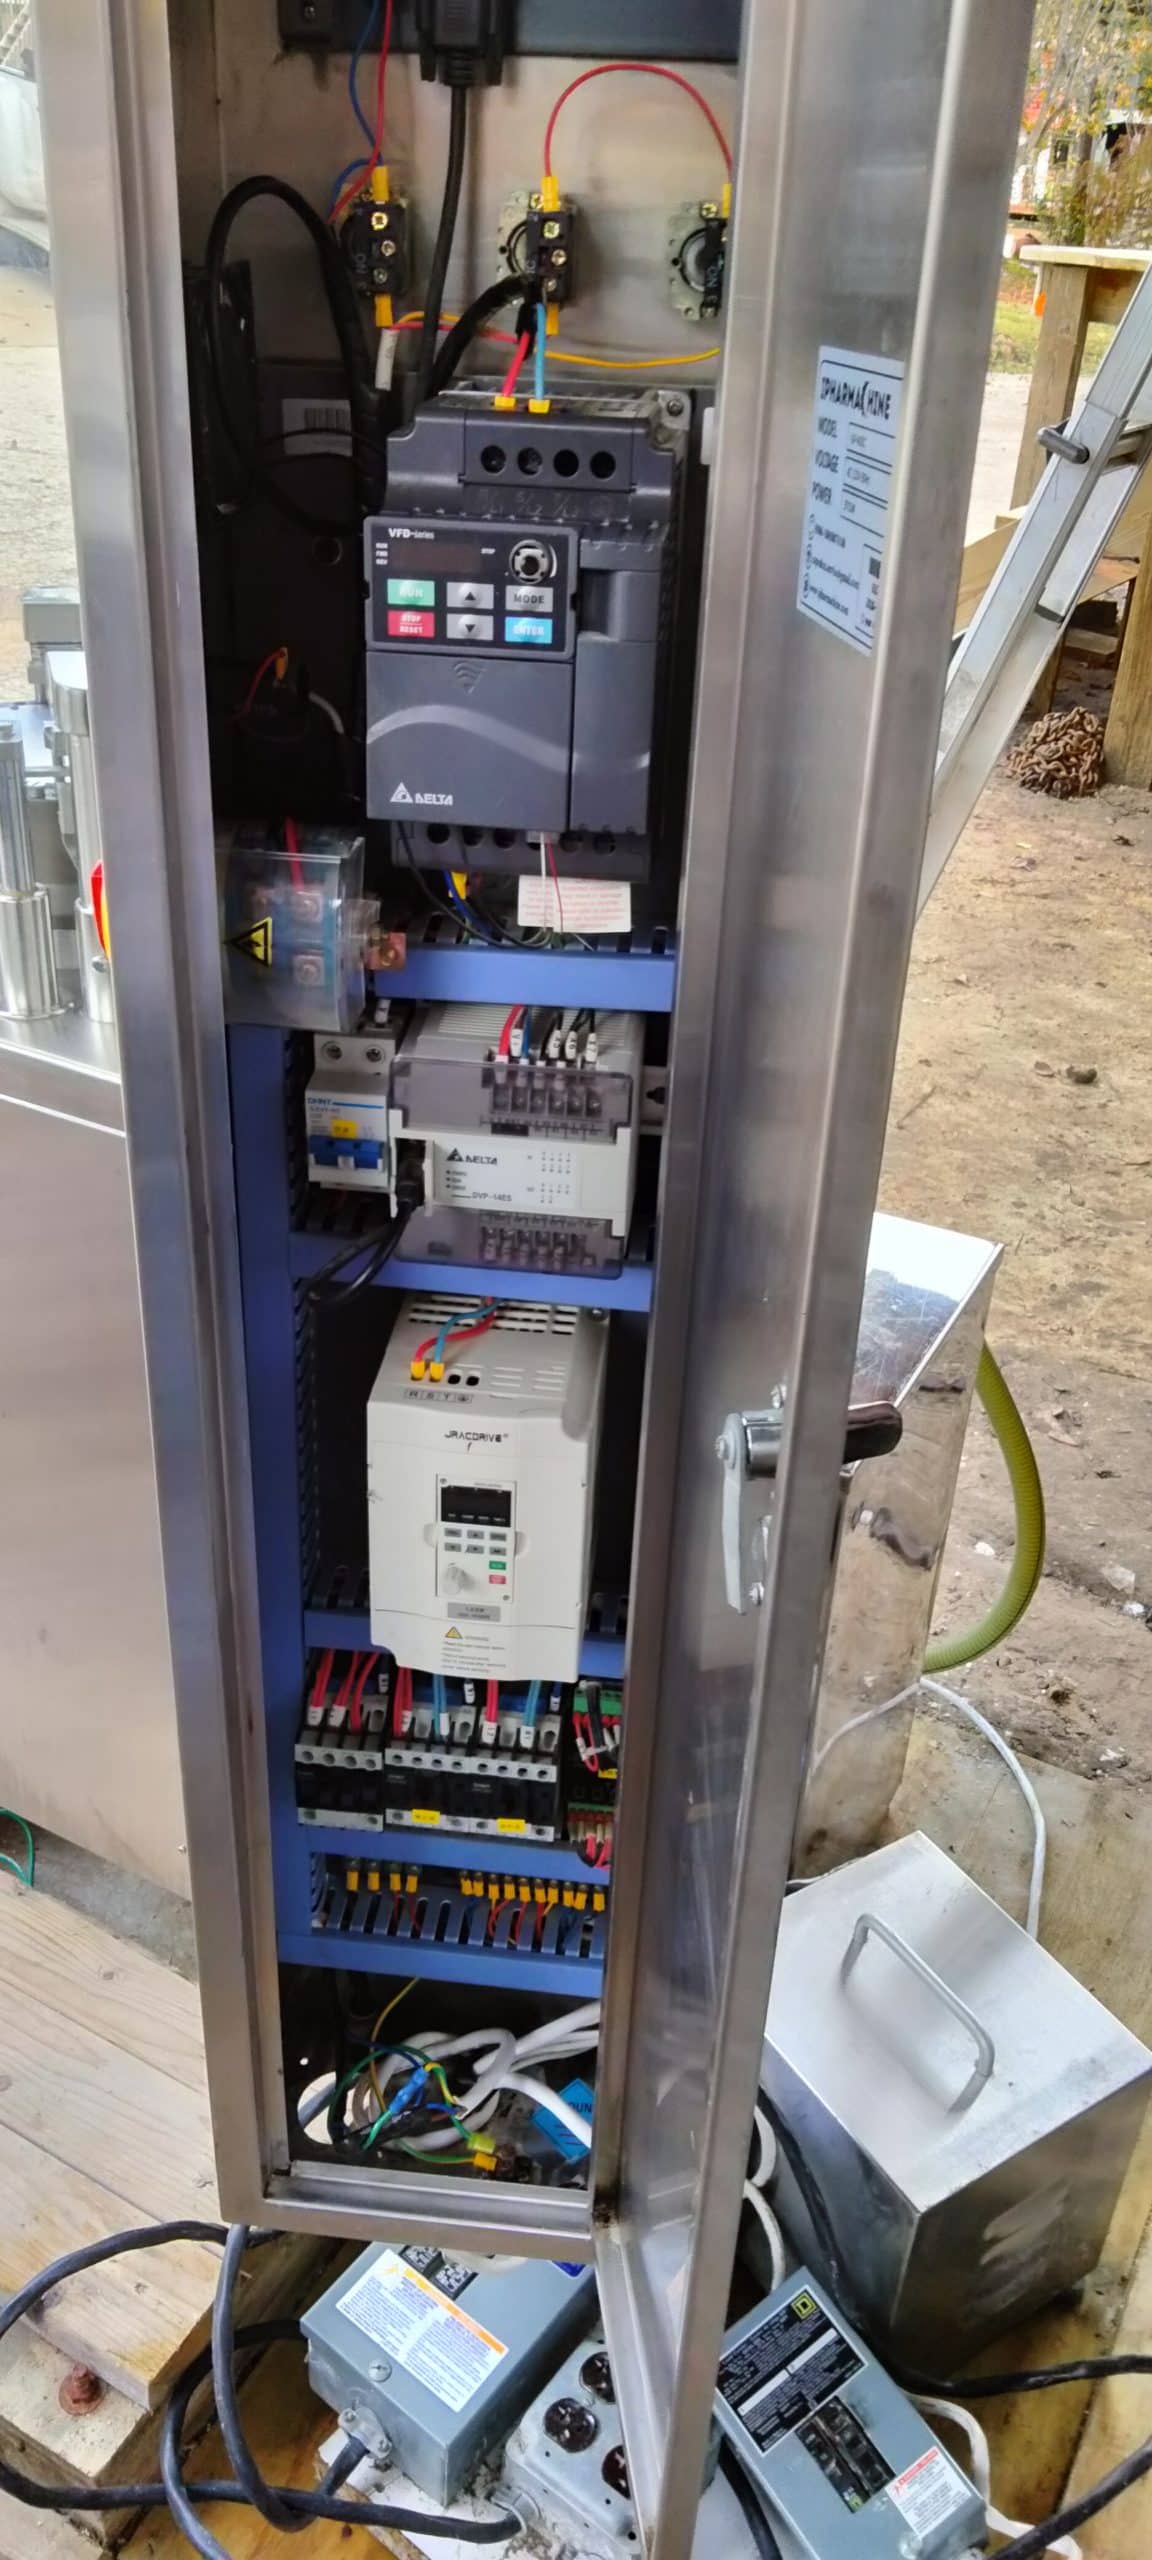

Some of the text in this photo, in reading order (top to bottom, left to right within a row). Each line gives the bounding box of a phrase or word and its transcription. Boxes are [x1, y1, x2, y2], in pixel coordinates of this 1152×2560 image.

[817, 416, 838, 438] MODEL
[815, 449, 839, 474] VOLTAGE
[812, 481, 832, 505] POWER
[399, 586, 423, 598] RUN
[513, 593, 545, 604] MODE
[401, 613, 422, 623] STOP
[399, 625, 423, 634] RESET
[513, 624, 545, 636] ENTER
[415, 792, 453, 806] DELTA
[465, 1154, 498, 1165] DELTA
